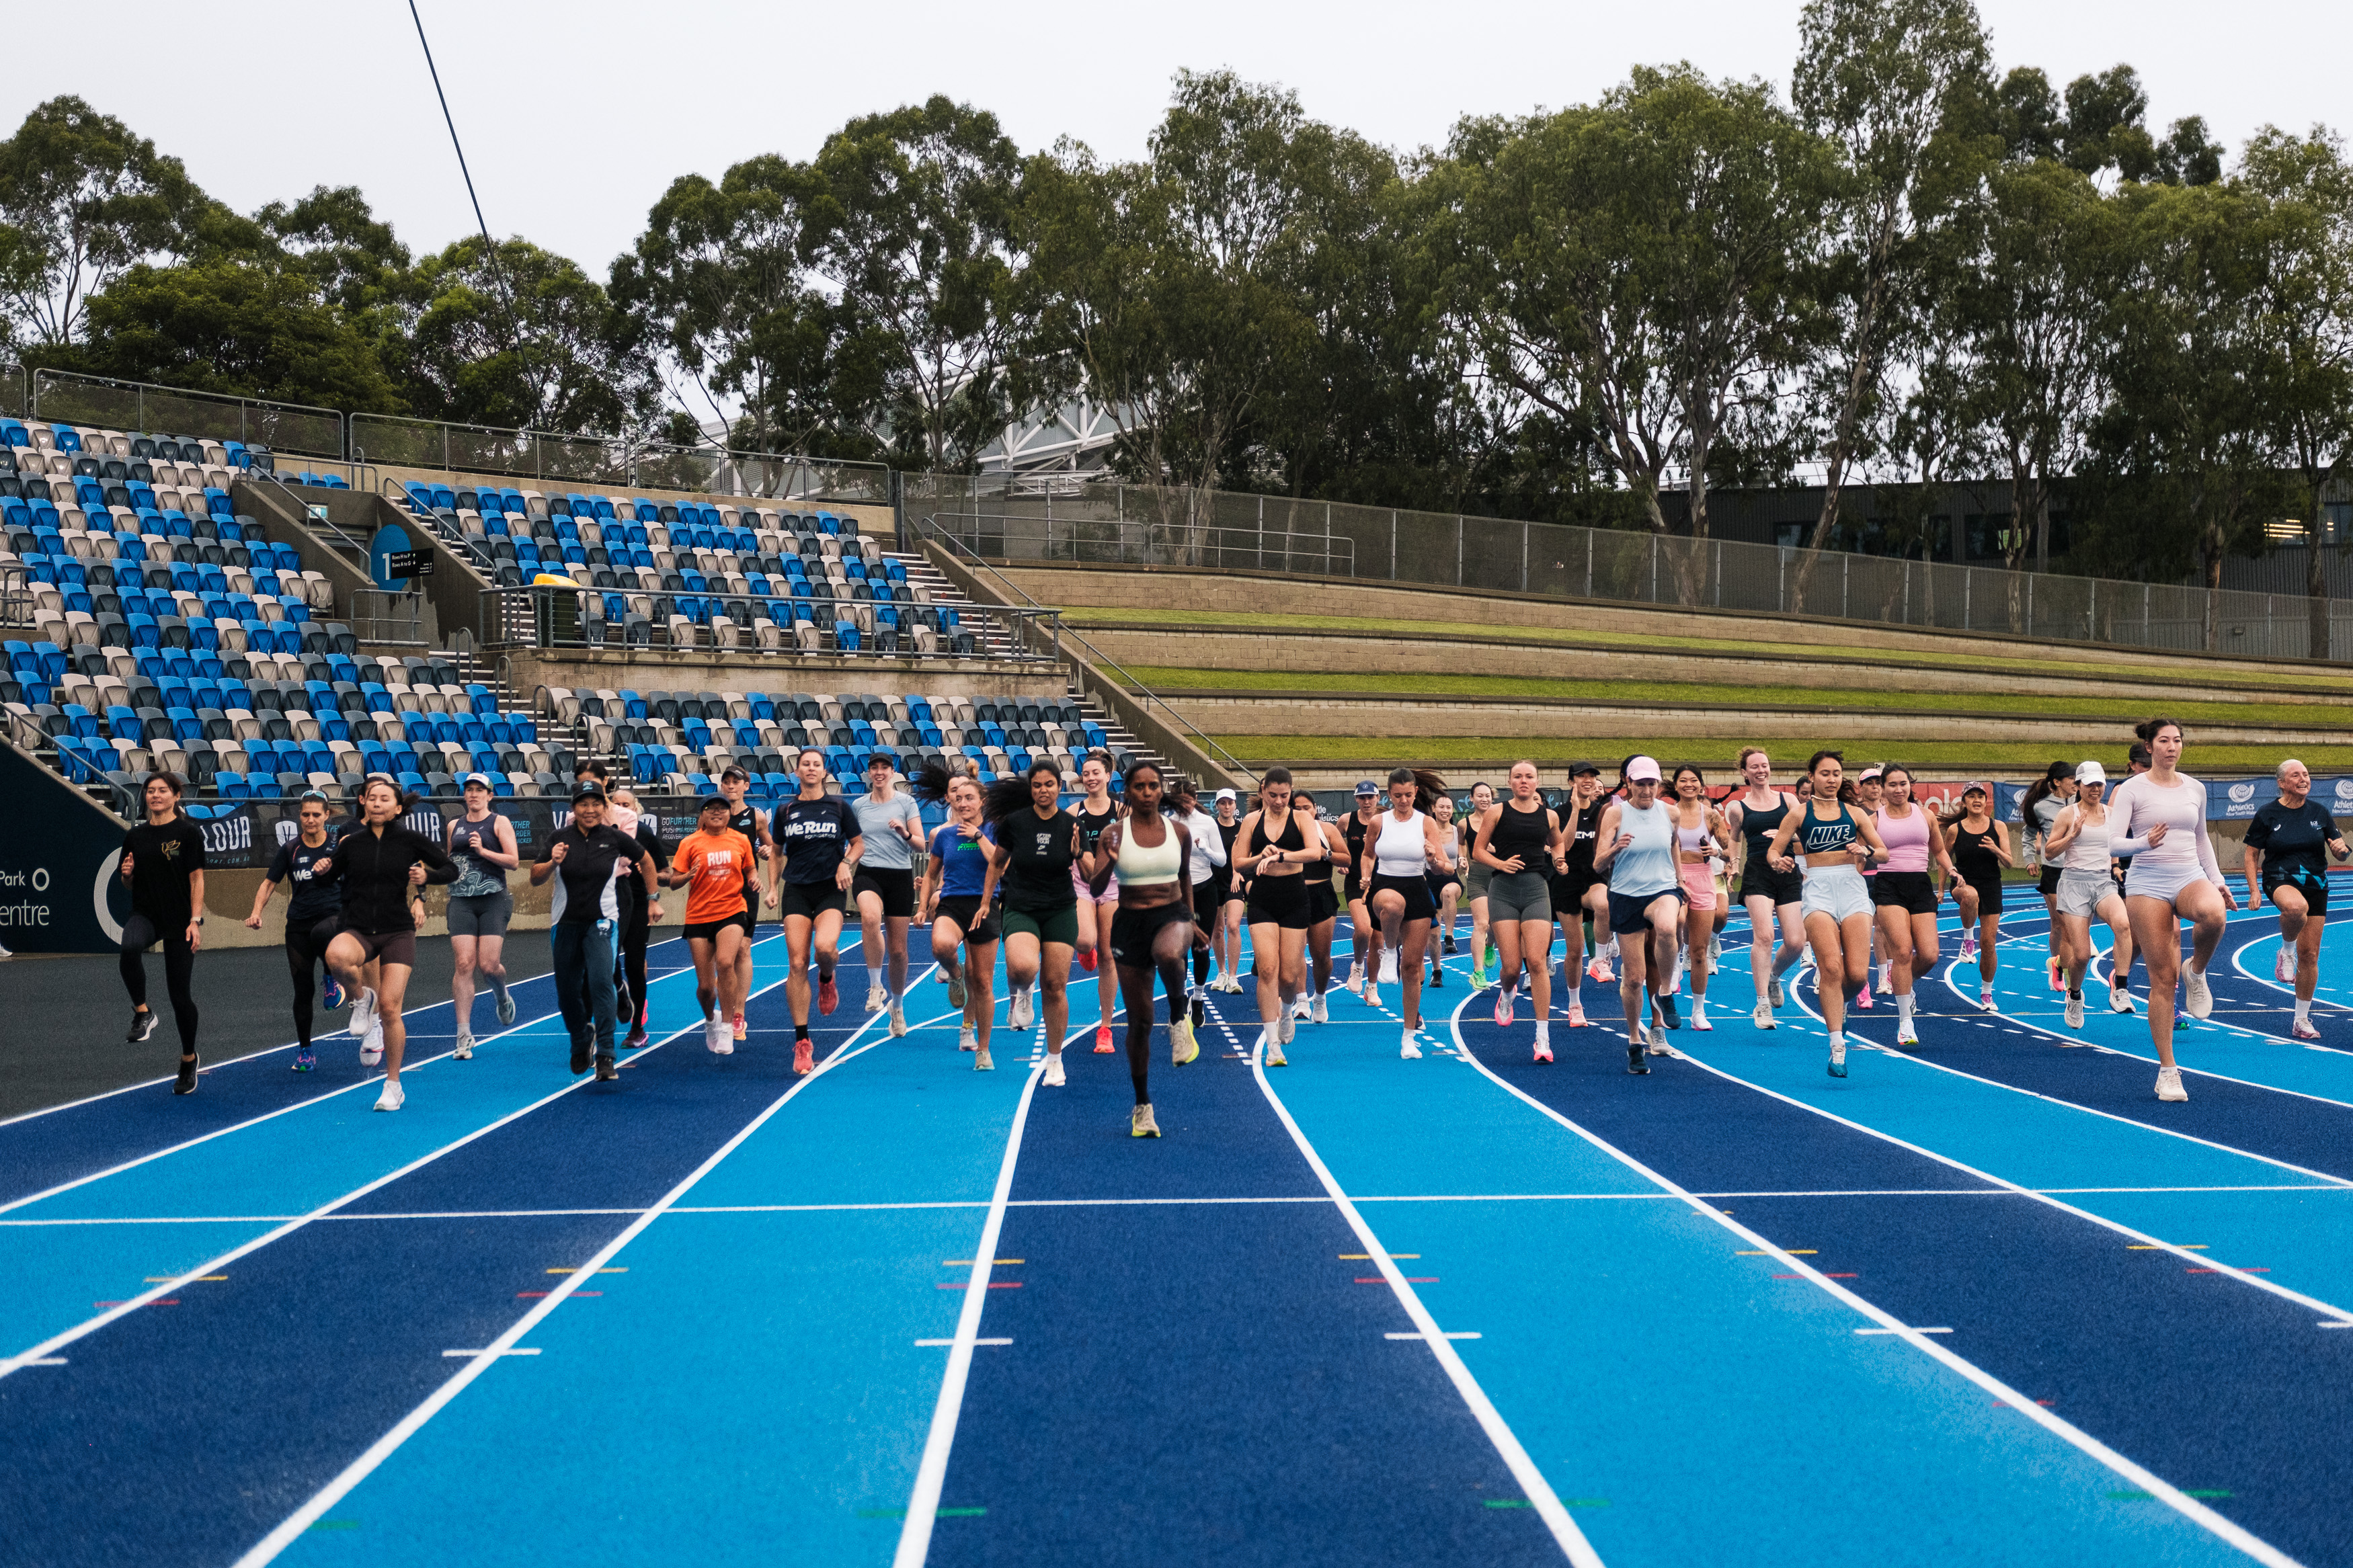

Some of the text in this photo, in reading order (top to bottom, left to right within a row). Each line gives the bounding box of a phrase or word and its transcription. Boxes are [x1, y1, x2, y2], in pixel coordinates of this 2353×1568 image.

[383, 553, 389, 580] 1
[1809, 825, 1850, 845] NIKE
[707, 850, 731, 866] RUN
